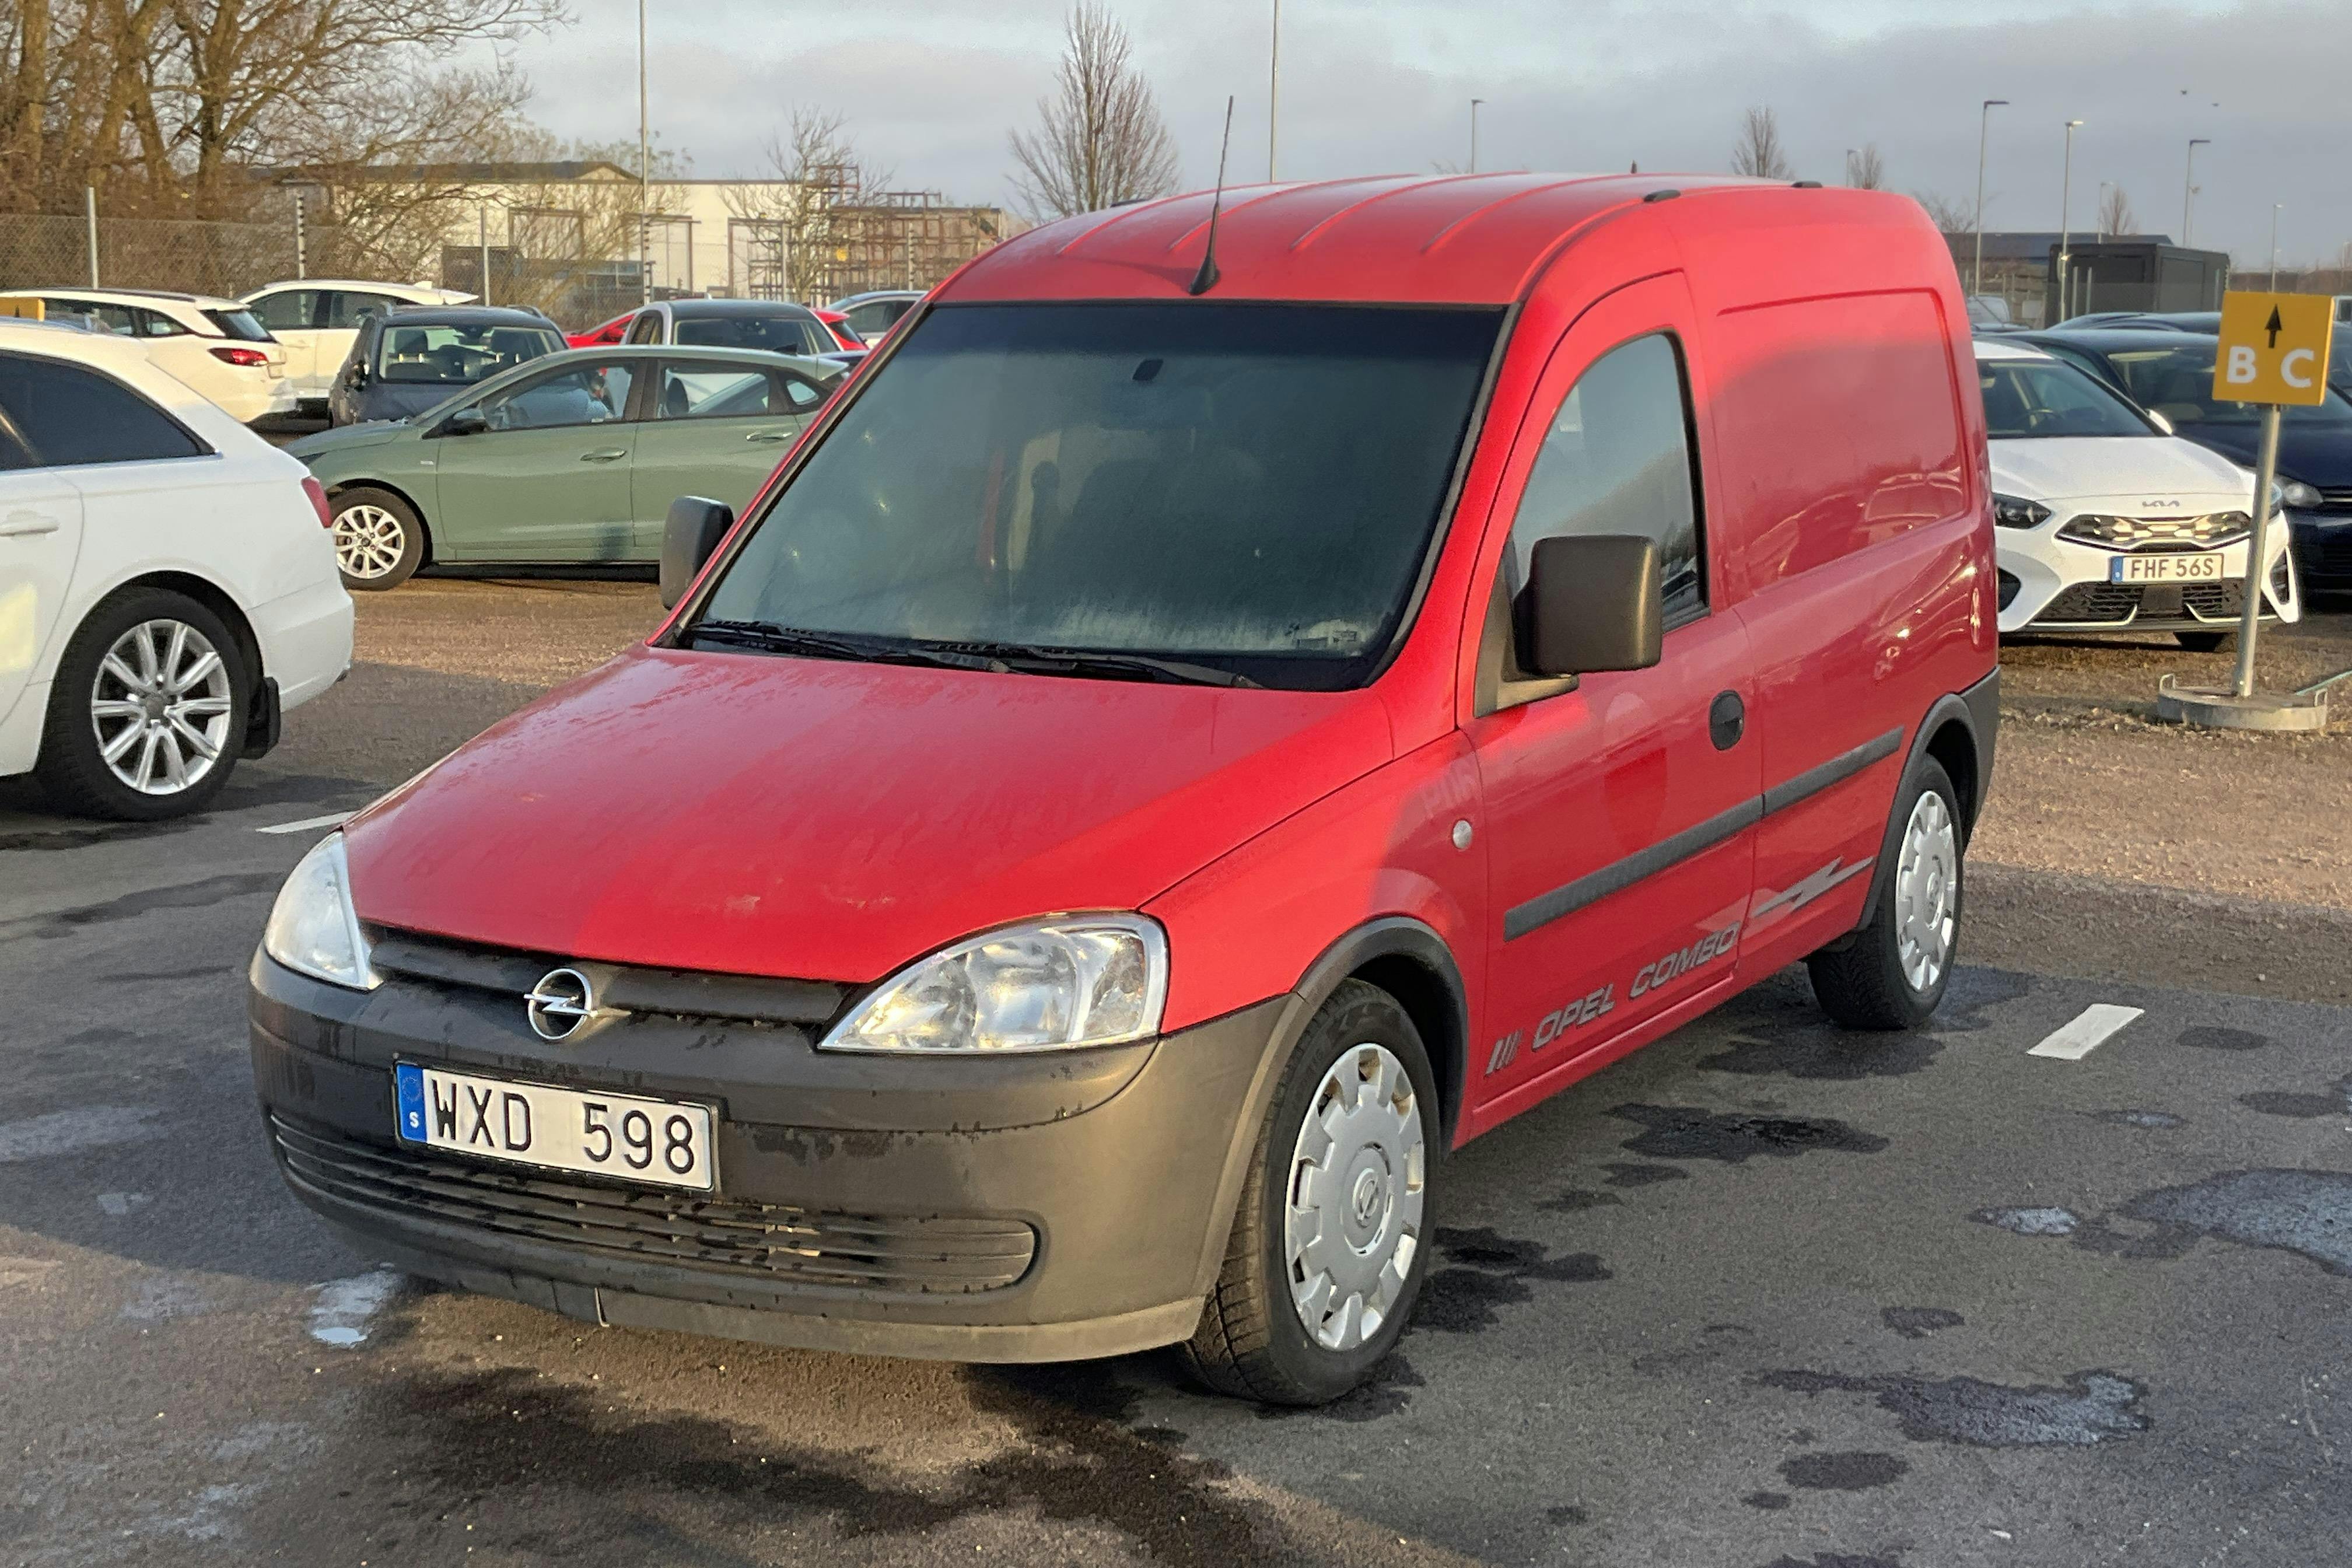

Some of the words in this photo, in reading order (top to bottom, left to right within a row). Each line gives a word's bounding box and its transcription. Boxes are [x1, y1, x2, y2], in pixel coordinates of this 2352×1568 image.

[2226, 346, 2256, 384] B
[2280, 348, 2314, 388] C
[2130, 558, 2169, 579] FHF
[1531, 984, 1616, 1051] OPEL
[1629, 921, 1741, 1000] COMBO
[409, 1111, 419, 1128] S
[432, 1078, 532, 1152] WXD
[582, 1101, 695, 1174] 598
